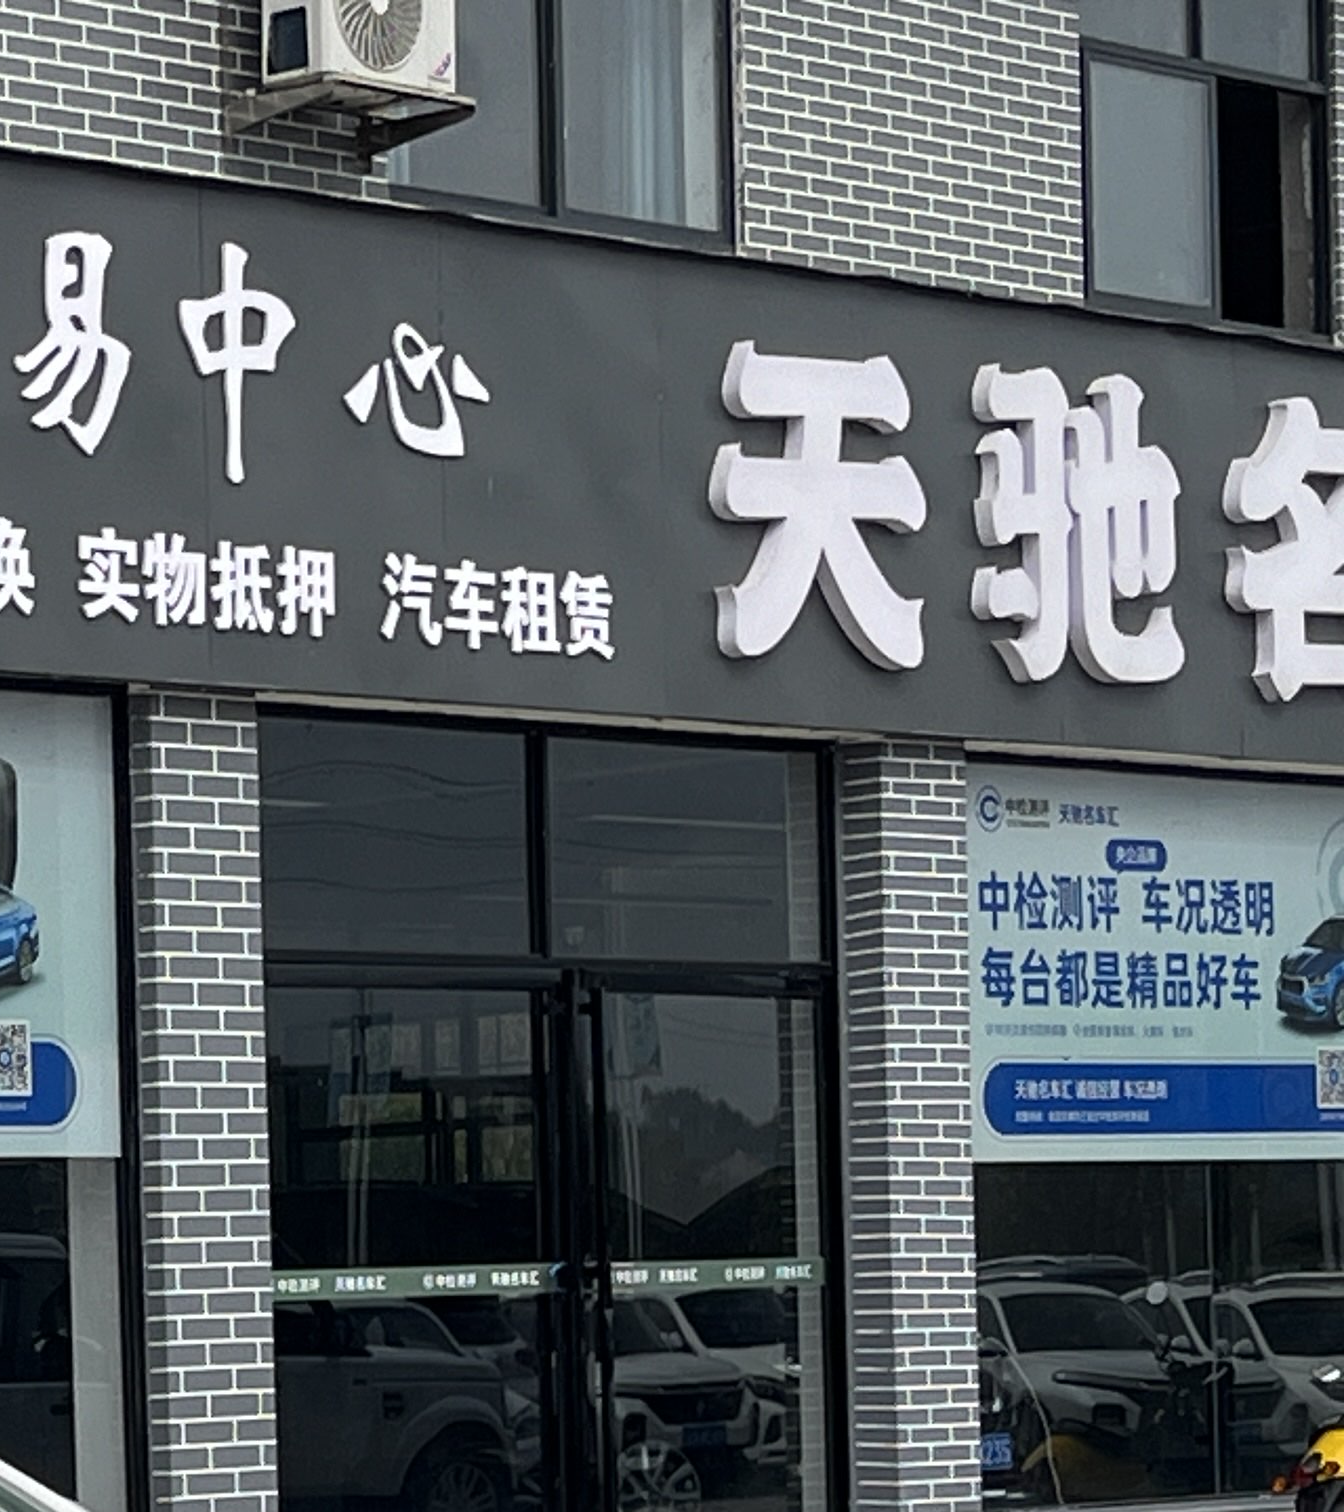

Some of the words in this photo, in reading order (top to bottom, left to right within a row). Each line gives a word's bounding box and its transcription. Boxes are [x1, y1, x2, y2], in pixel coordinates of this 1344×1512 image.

[76, 527, 337, 638] 实物抵押
[379, 552, 616, 660] 汽车租赁
[978, 870, 1120, 933] 中检测评
[1141, 876, 1274, 936] 车况透明
[981, 947, 1262, 1010] 每台都是精品好车
